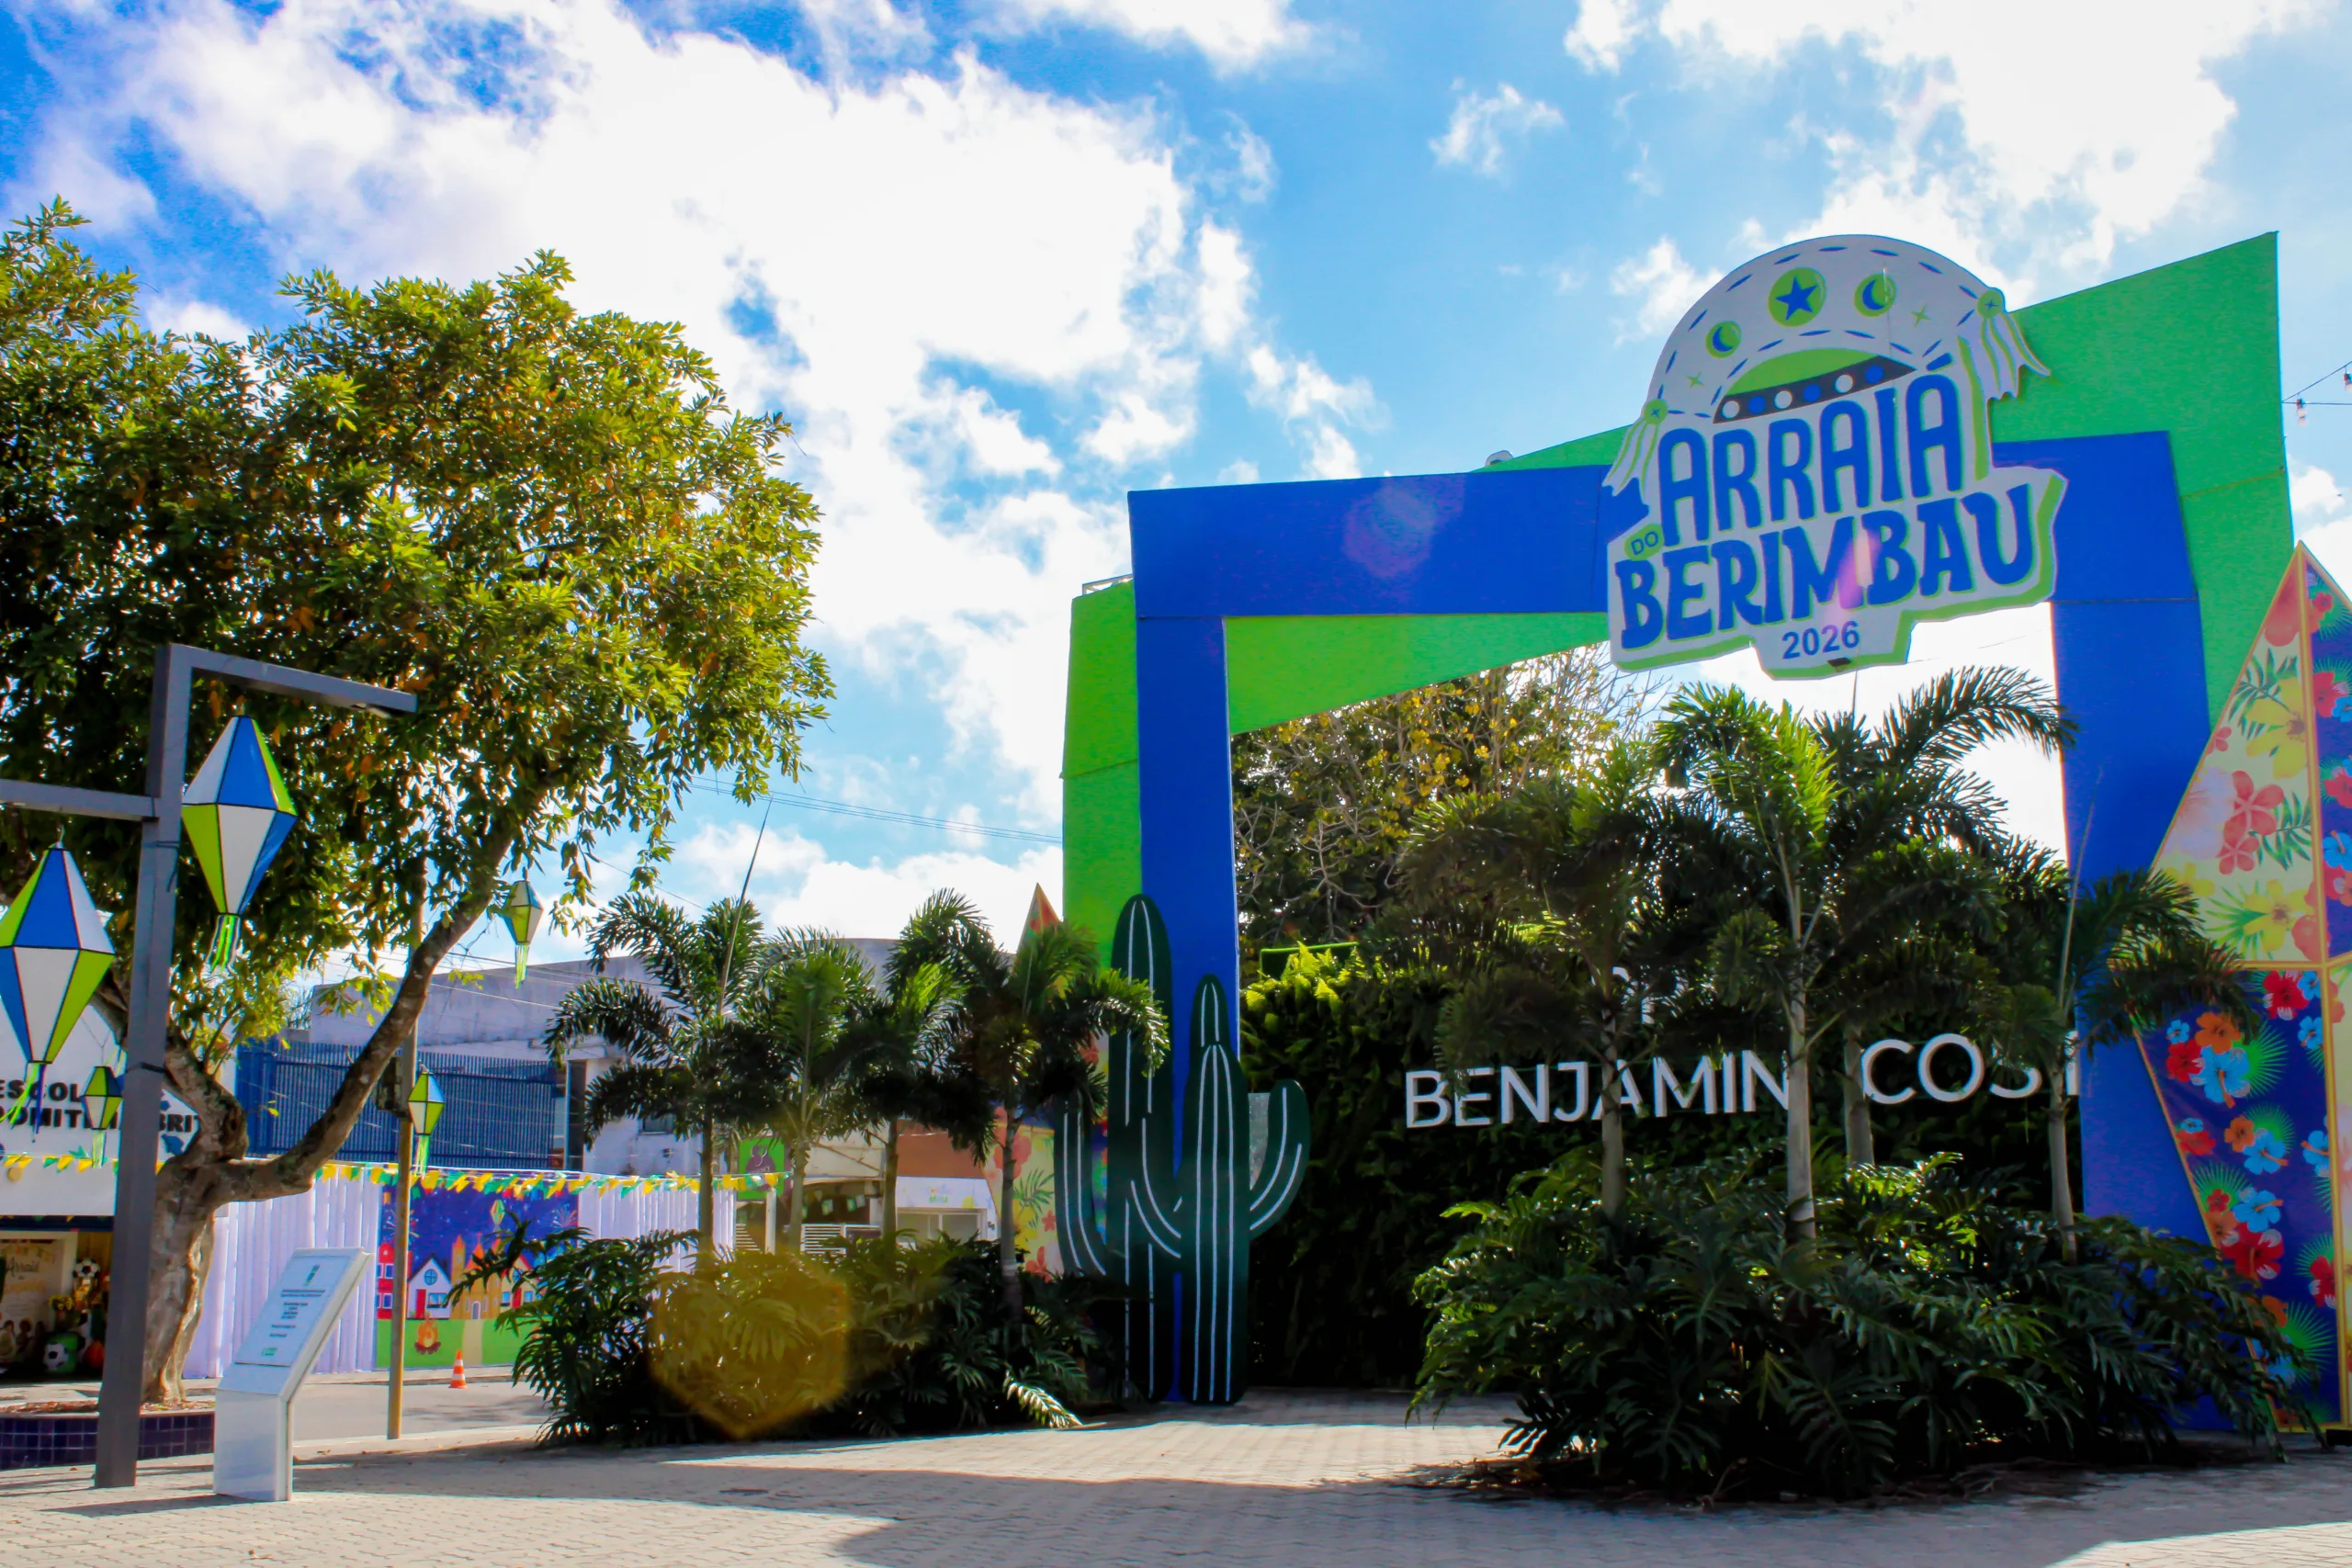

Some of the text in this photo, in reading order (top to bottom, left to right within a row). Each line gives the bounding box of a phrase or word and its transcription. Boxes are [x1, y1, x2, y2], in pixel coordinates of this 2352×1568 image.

[1657, 353, 1963, 547] ARRAIÁ
[1614, 482, 2032, 650] BERIMBAU
[1631, 531, 1659, 556] DO
[1781, 620, 1860, 660] 2026
[1406, 1050, 1790, 1128] BENJAMIN
